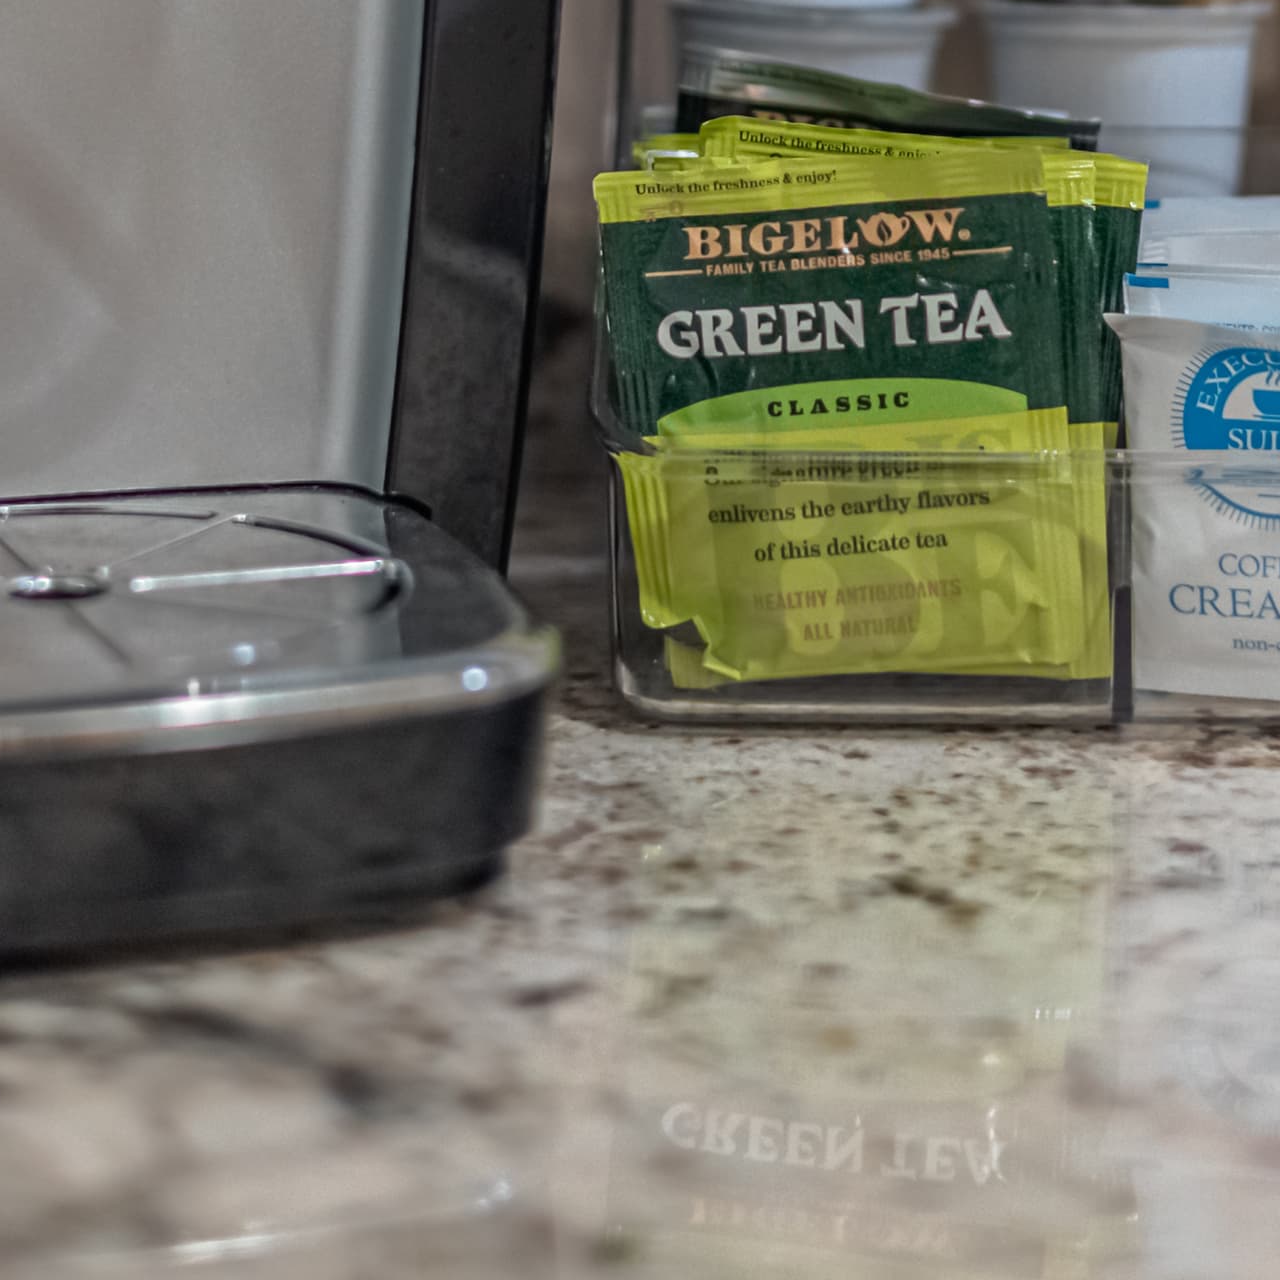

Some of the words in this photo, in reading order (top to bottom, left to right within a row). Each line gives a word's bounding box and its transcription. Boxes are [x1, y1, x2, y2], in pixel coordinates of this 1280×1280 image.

[738, 129, 787, 148] Unlock
[790, 135, 813, 151] the
[635, 181, 685, 196] Unlock
[687, 181, 710, 194] the
[713, 174, 781, 192] freshness
[782, 172, 793, 185] &
[795, 169, 838, 186] enjoy!
[706, 262, 754, 278] FAMILY
[759, 260, 787, 274] TEA
[790, 253, 866, 272] BLENDERS
[870, 250, 913, 266] SINCE
[919, 246, 951, 262] 1945
[656, 297, 867, 360] GREEN
[878, 287, 1013, 350] TEA
[766, 390, 911, 419] CLASSIC
[707, 503, 797, 524] enlivens
[801, 498, 836, 519] the
[841, 494, 912, 517] earthy
[917, 488, 991, 510] flavors
[754, 541, 777, 562] of
[780, 539, 822, 561] this
[826, 533, 911, 557] delicate
[915, 532, 949, 549] tea
[752, 589, 828, 610] HEALTHY
[835, 578, 962, 606] ANTIOXIDANTS
[803, 623, 833, 641] ALL
[840, 616, 917, 639] NATURAL
